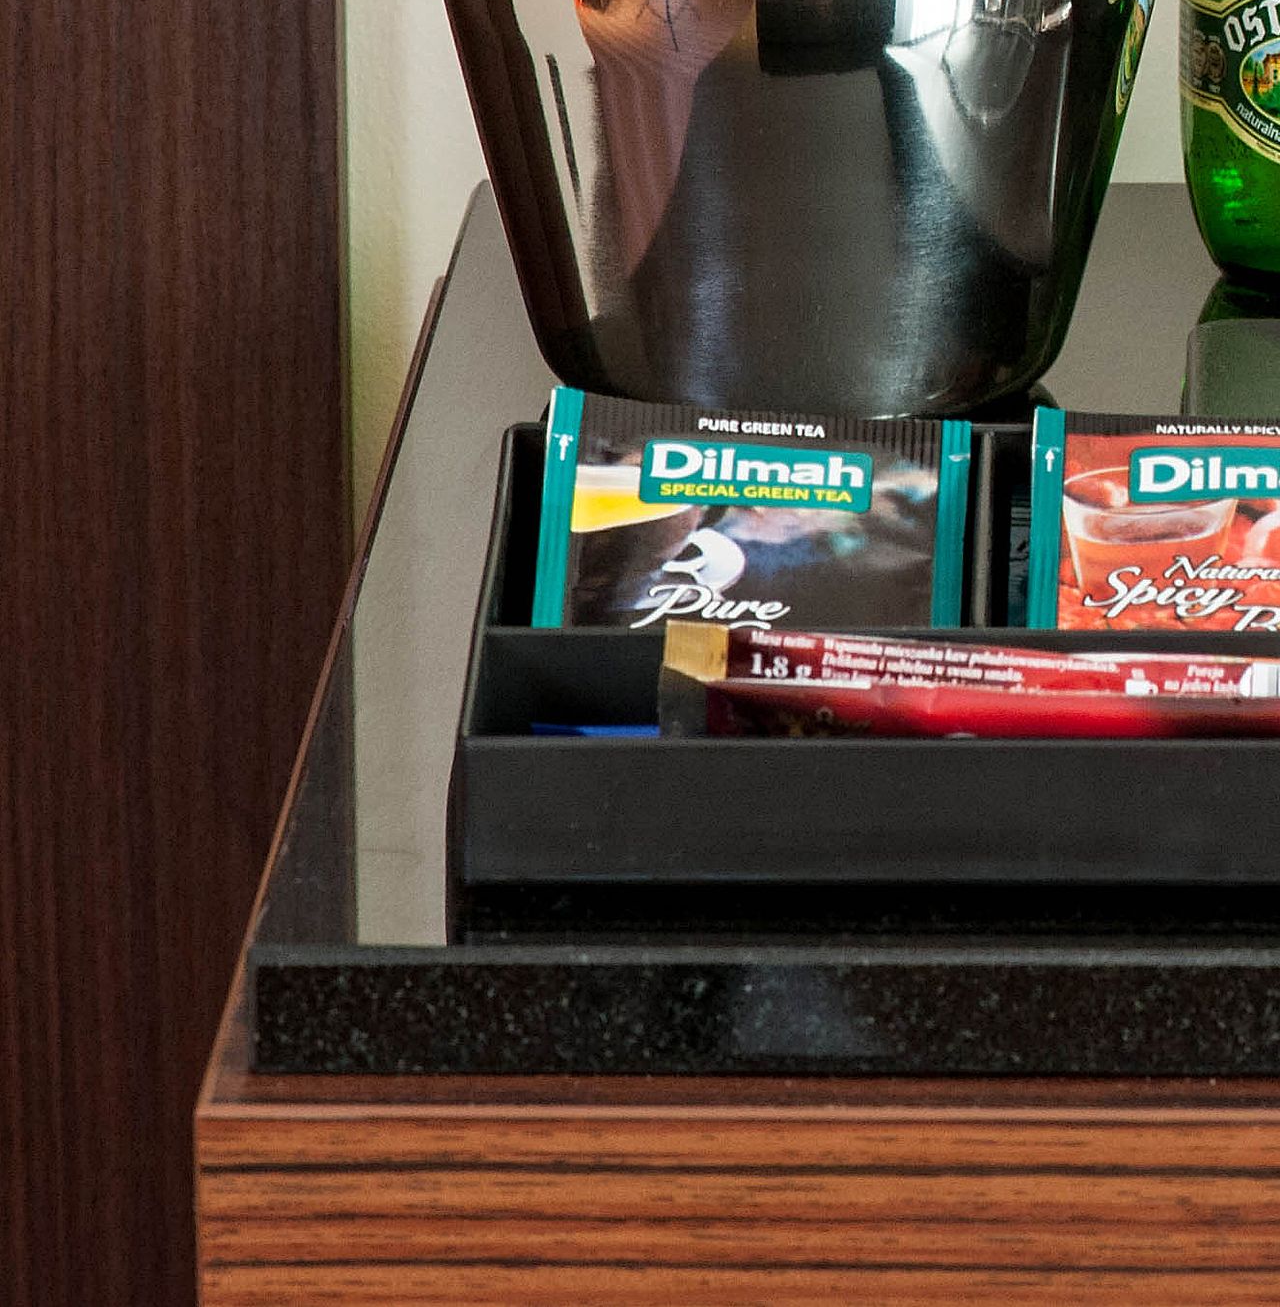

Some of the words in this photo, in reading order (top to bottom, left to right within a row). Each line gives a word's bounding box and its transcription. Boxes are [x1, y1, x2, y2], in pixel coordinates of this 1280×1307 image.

[698, 418, 739, 434] PURE
[740, 421, 793, 437] GREEN
[795, 424, 826, 439] TEA
[1156, 424, 1242, 435] NATURALLY
[649, 443, 864, 489] Dilmah
[660, 483, 739, 499] SPECIAL
[743, 485, 810, 502] GREEN
[813, 489, 852, 504] TEA
[1084, 565, 1244, 619] Spicy
[629, 584, 791, 631] Pure
[752, 654, 788, 678] 1,8
